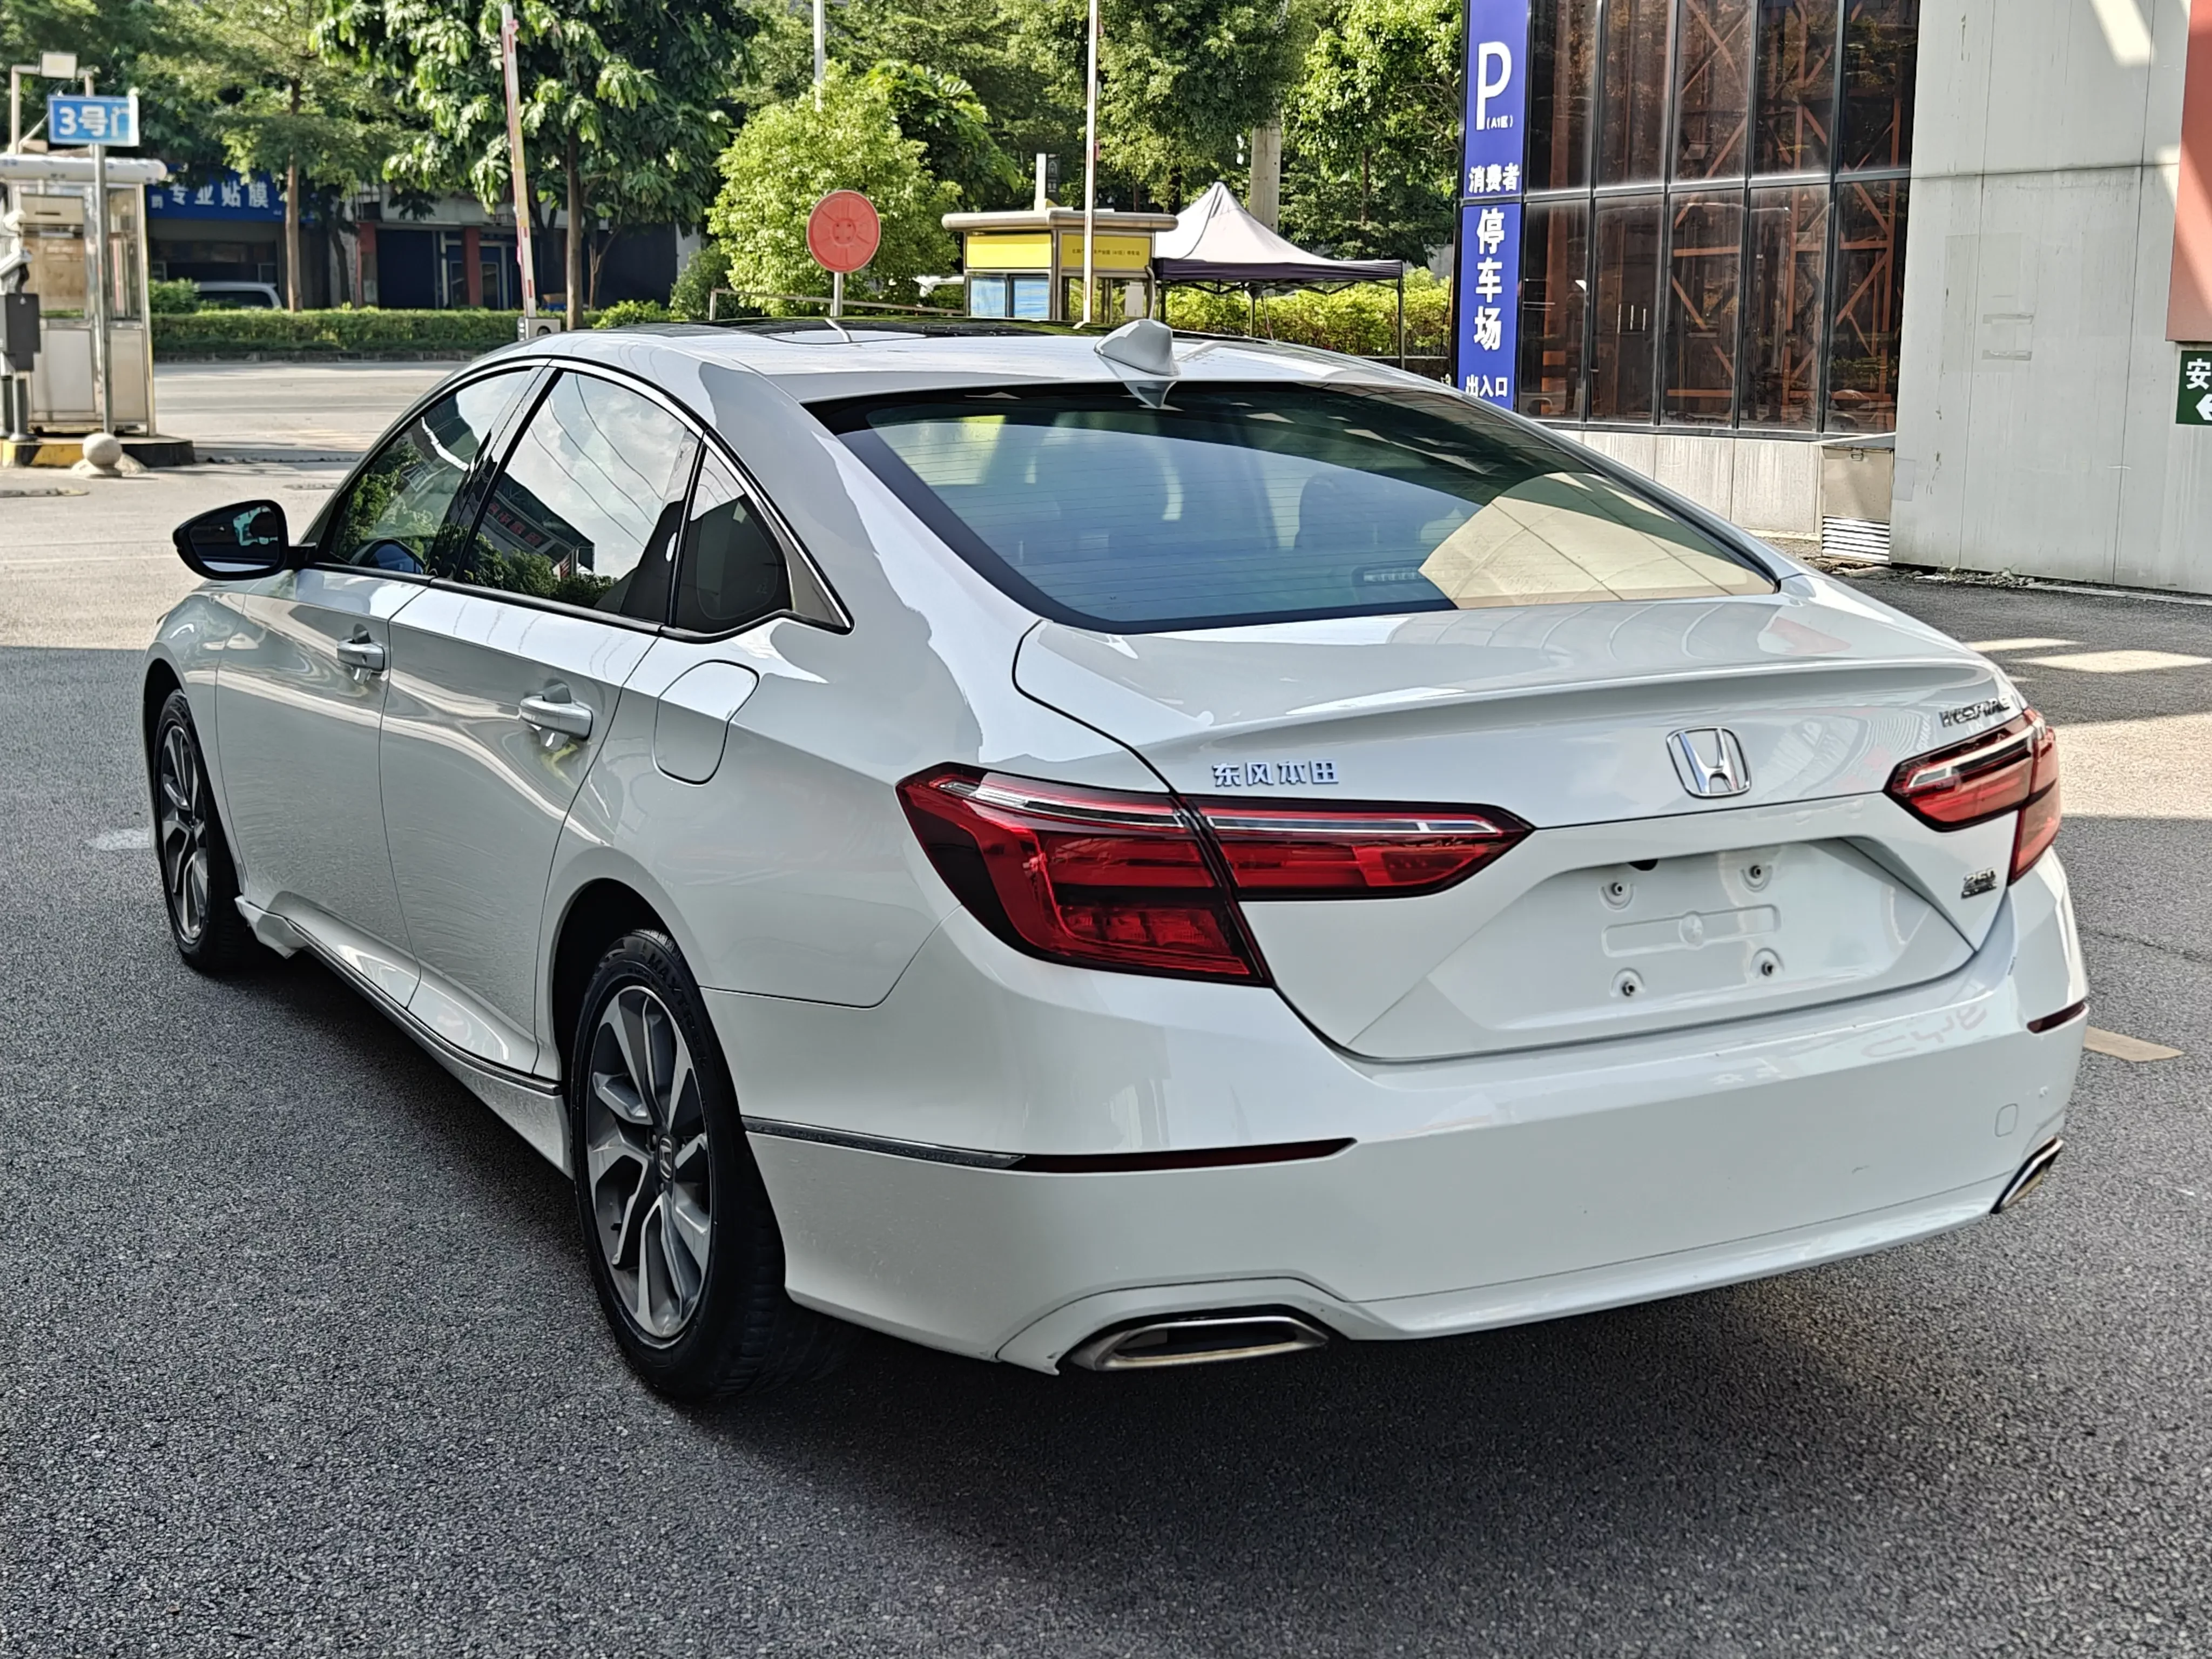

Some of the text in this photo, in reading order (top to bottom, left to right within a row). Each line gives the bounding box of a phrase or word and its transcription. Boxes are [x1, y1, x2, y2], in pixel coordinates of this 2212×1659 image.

[1476, 41, 1512, 130] P
[1468, 162, 1520, 193] 消费者
[1473, 207, 1505, 352] 停车场
[1465, 374, 1508, 398] 出入口
[2186, 358, 2212, 390] 安
[1212, 759, 1339, 787] 东风本田
